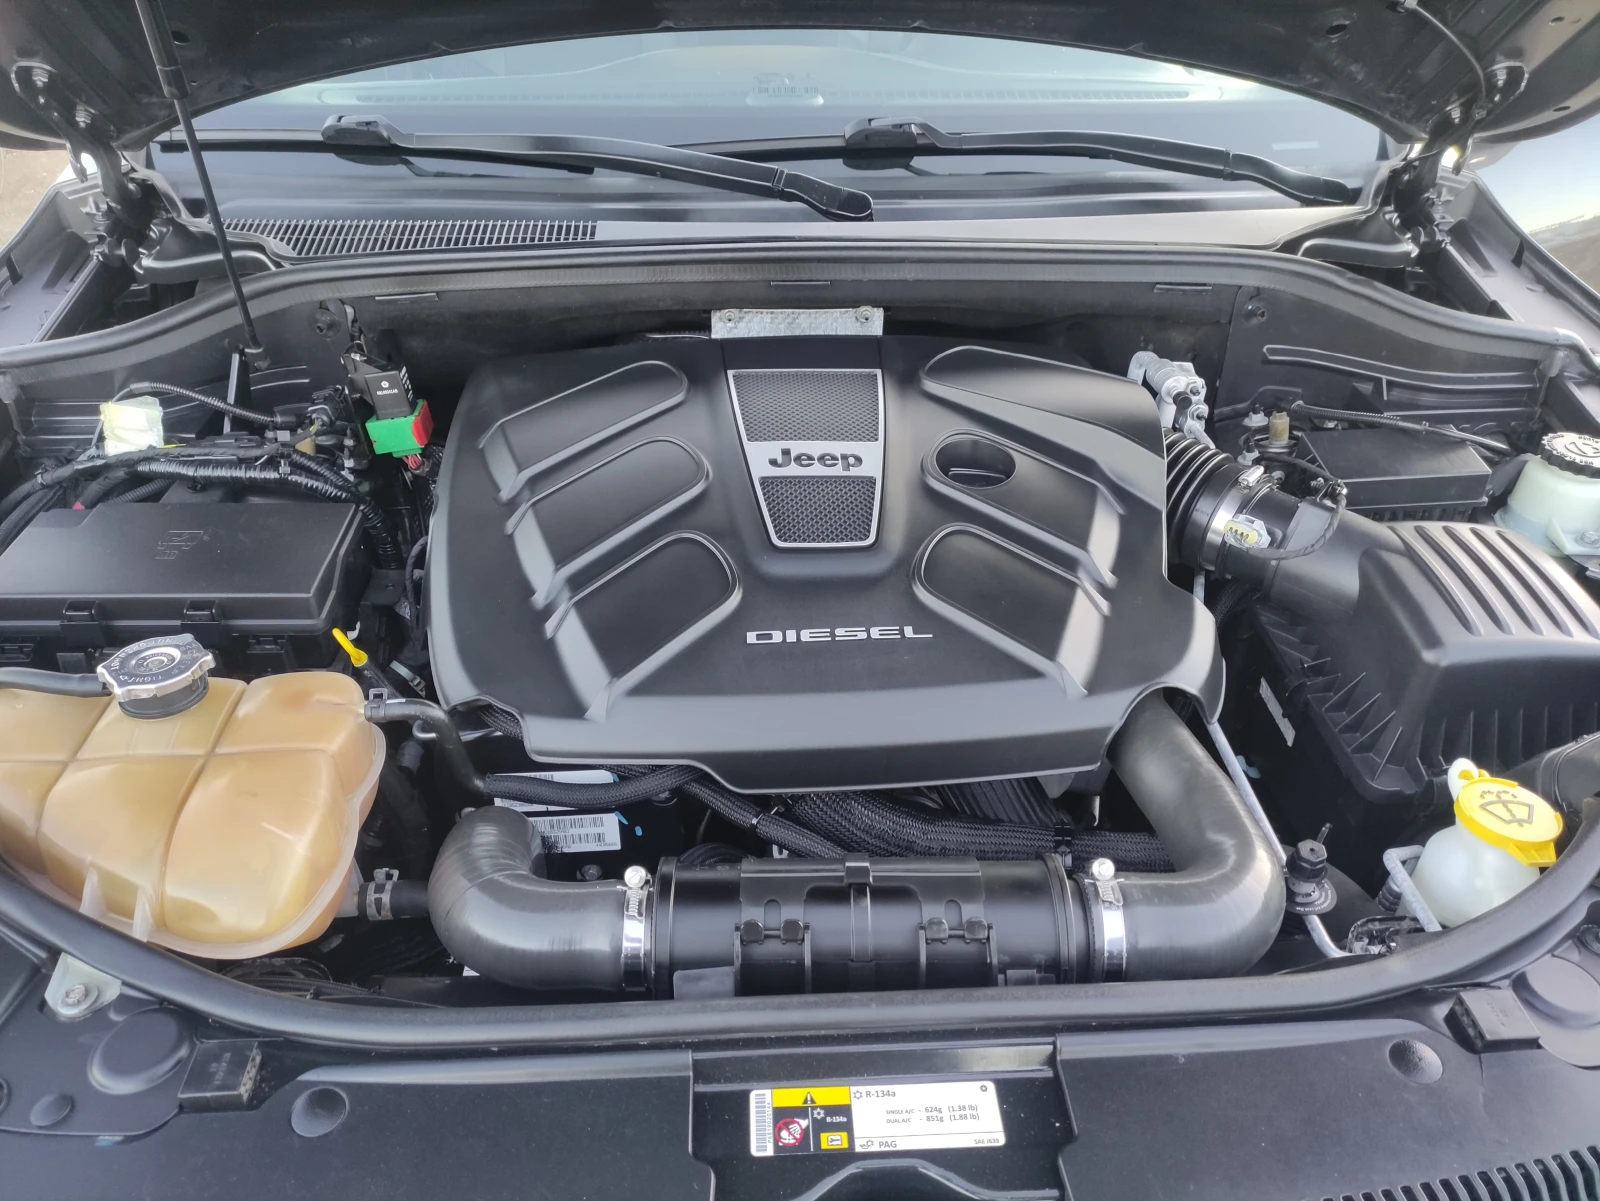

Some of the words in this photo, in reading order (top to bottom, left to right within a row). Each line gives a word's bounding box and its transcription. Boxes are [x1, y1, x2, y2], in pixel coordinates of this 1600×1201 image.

[768, 448, 863, 471] Jeep
[746, 626, 933, 644] DIESEL
[865, 1089, 896, 1098] R-134a
[924, 1106, 943, 1115] 624g
[947, 1104, 967, 1113] (1.38
[968, 1104, 978, 1112] lb)
[926, 1115, 944, 1123] 851g
[949, 1114, 969, 1122] (1.88
[969, 1113, 980, 1121] lb)
[878, 1140, 897, 1149] PAG
